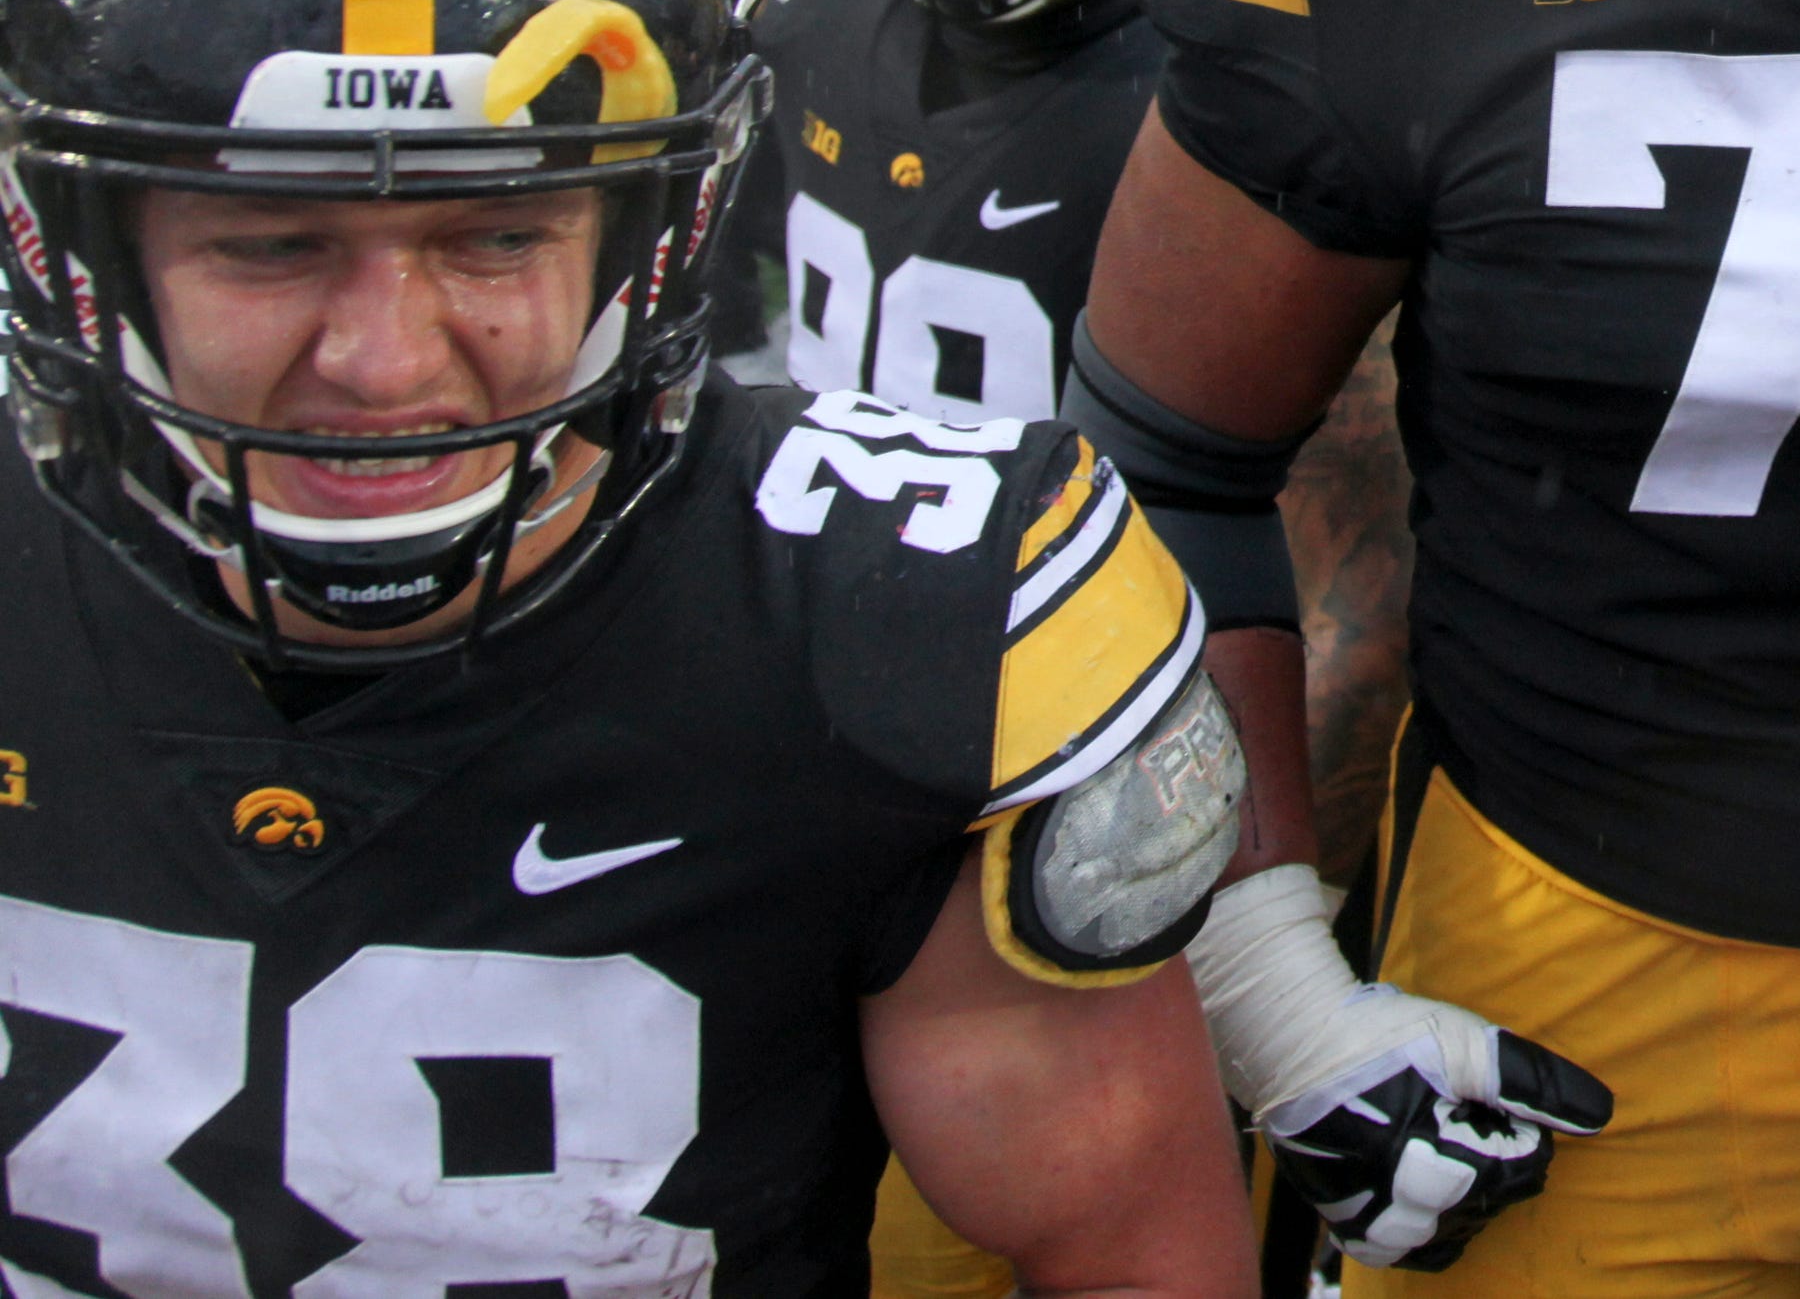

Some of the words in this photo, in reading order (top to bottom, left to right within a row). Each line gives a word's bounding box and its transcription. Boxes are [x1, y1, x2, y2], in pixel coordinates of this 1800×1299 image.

[324, 67, 453, 110] IOWA
[754, 389, 1027, 555] 38
[326, 574, 436, 603] Riddell
[0, 894, 717, 1299] 38
